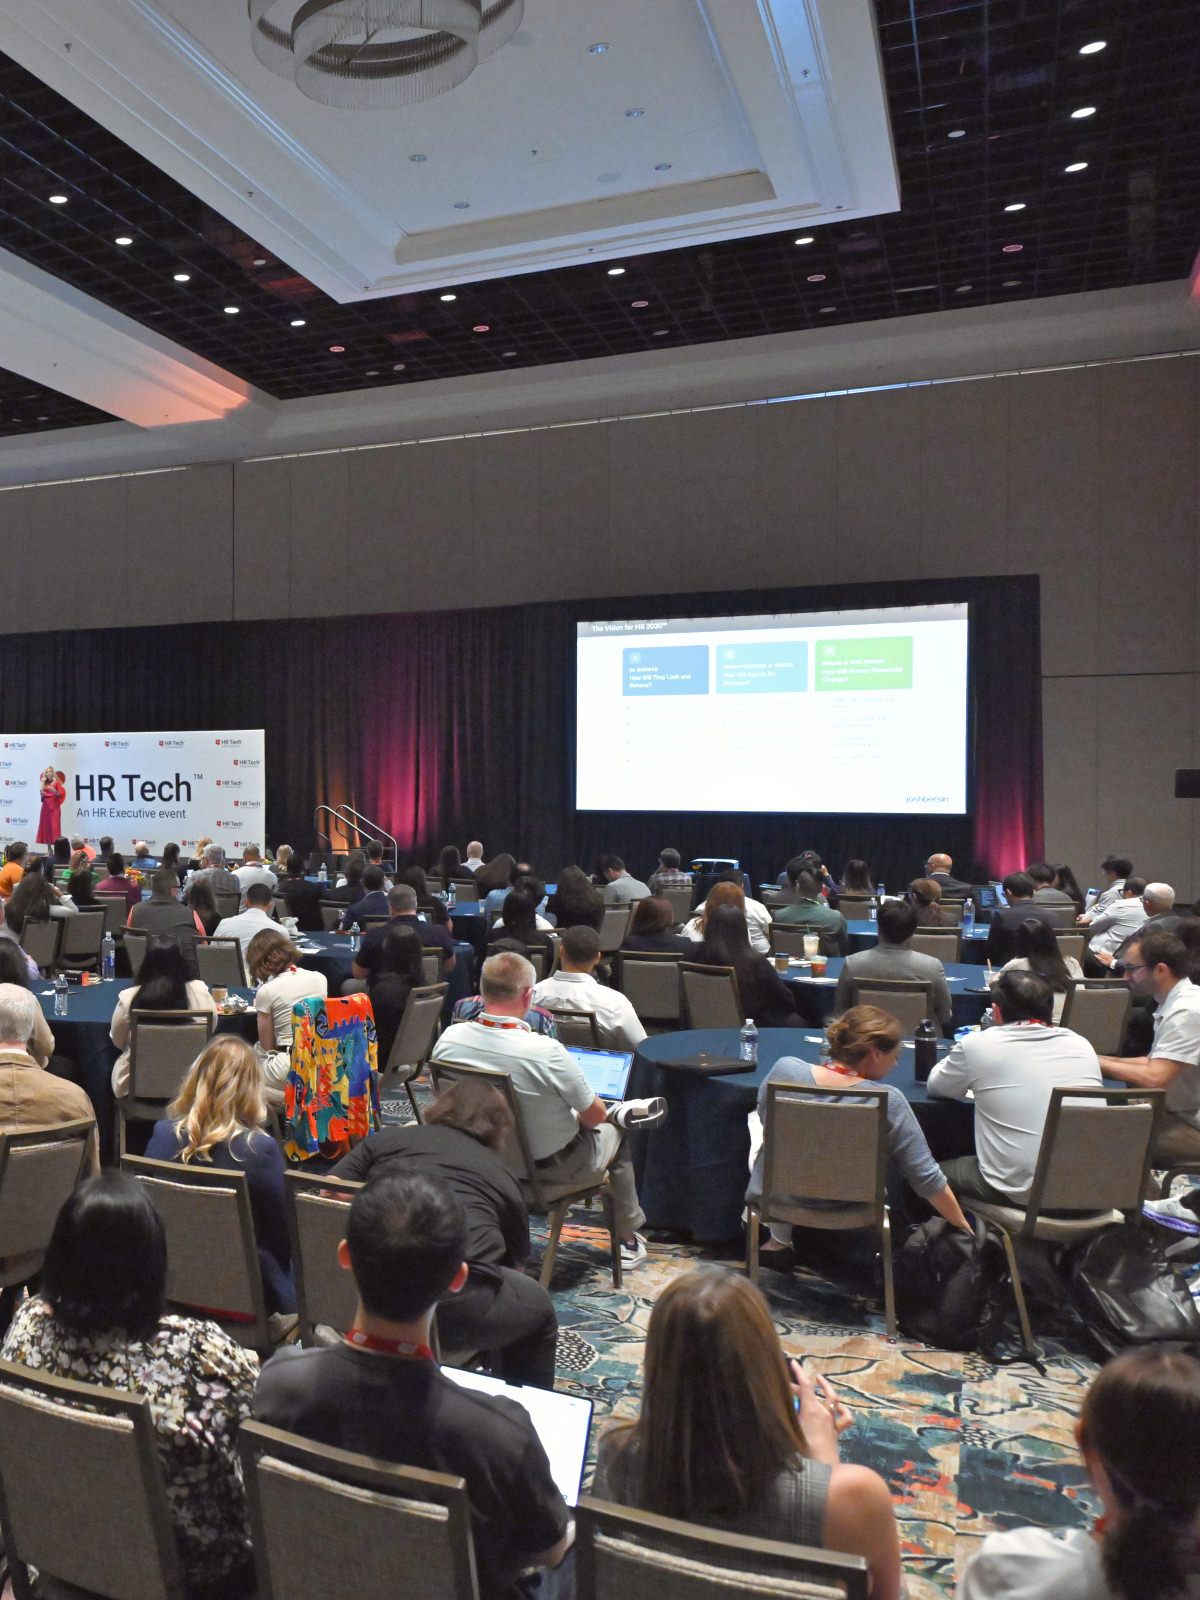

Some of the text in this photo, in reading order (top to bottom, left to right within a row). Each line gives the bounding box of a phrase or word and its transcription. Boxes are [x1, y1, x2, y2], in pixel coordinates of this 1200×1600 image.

[75, 774, 117, 802] HR
[121, 772, 192, 802] Tech
[76, 808, 186, 819] An HR Executive event
